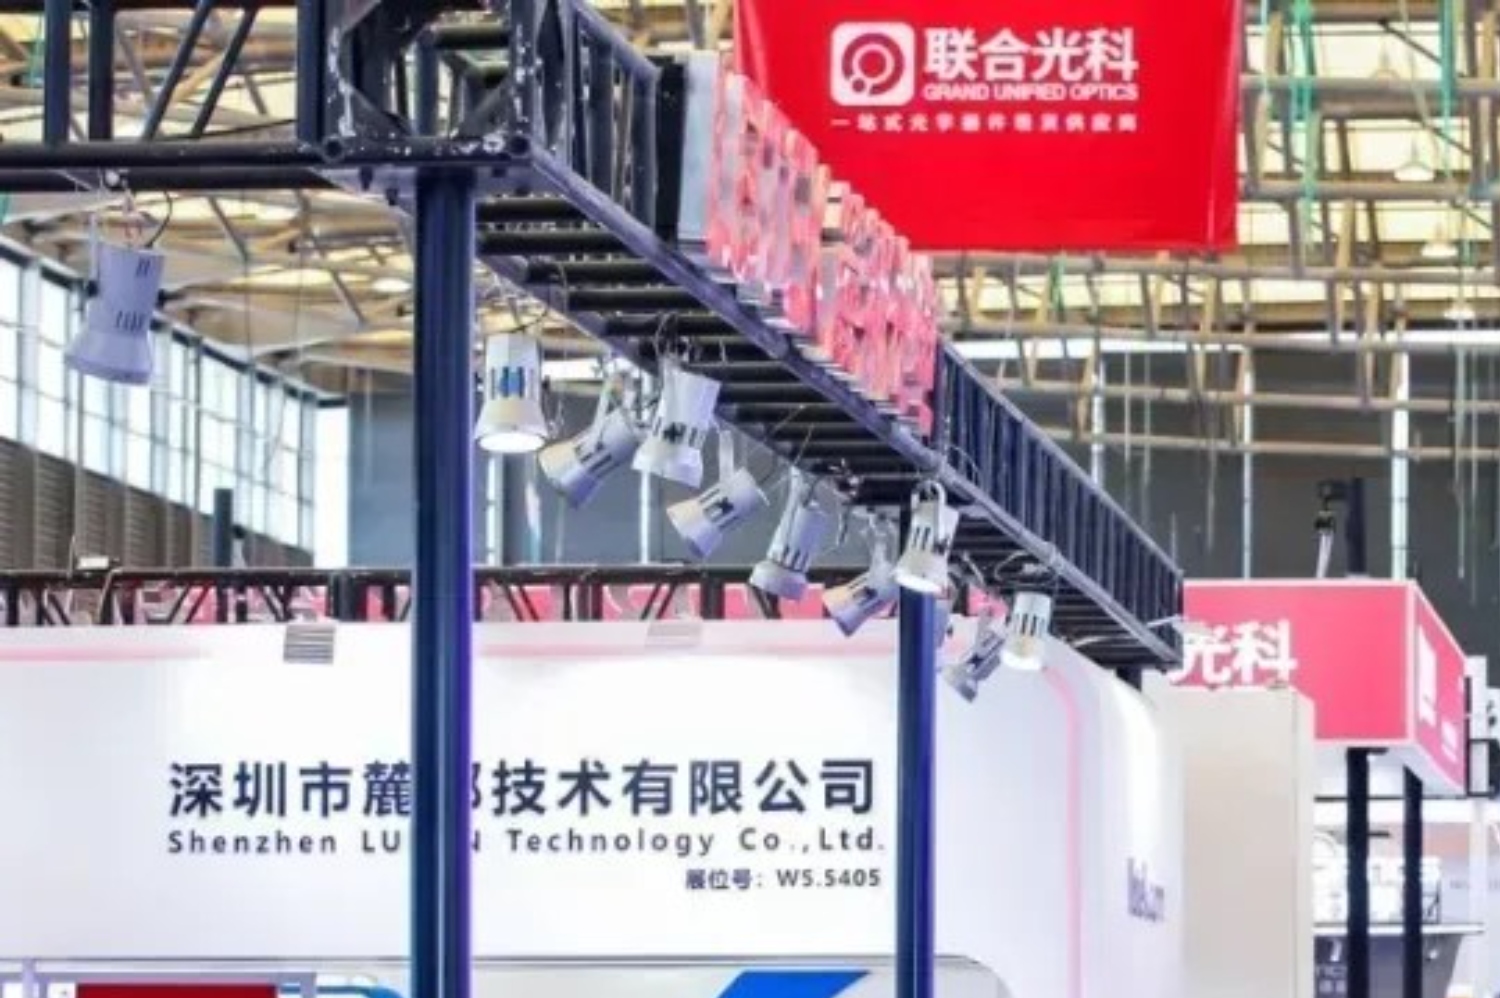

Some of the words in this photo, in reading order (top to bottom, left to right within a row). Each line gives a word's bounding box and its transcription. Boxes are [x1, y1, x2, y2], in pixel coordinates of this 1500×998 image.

[923, 27, 1139, 82] 联合光科
[923, 84, 989, 101] GRAND
[993, 84, 1065, 101] UNIFIED
[1069, 84, 1139, 101] OPTICS
[168, 759, 876, 818] 深圳市麓技术有限公司
[168, 829, 338, 853] Shenzhen
[507, 827, 715, 857] Technology
[738, 826, 886, 854] Co.,Ltd.
